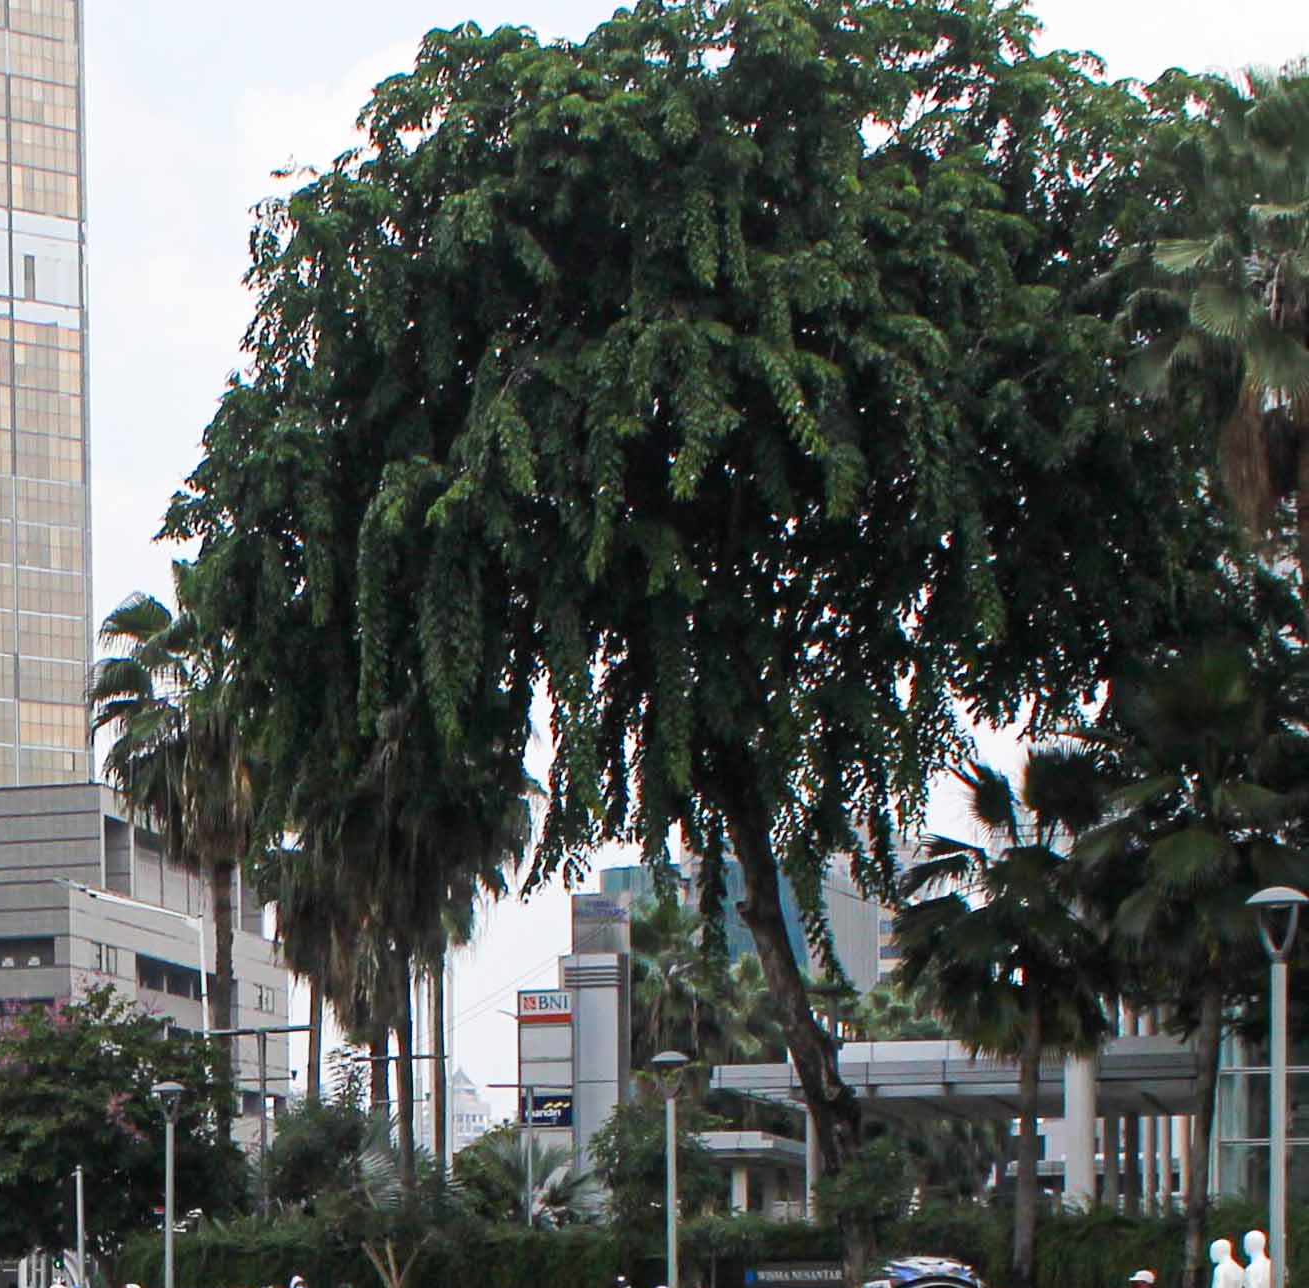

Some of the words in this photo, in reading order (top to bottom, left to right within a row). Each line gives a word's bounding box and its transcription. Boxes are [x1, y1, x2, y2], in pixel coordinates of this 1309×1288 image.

[539, 995, 568, 1010] BNI
[757, 1271, 789, 1281] WISMA
[791, 1270, 843, 1281] NUSANTAR
